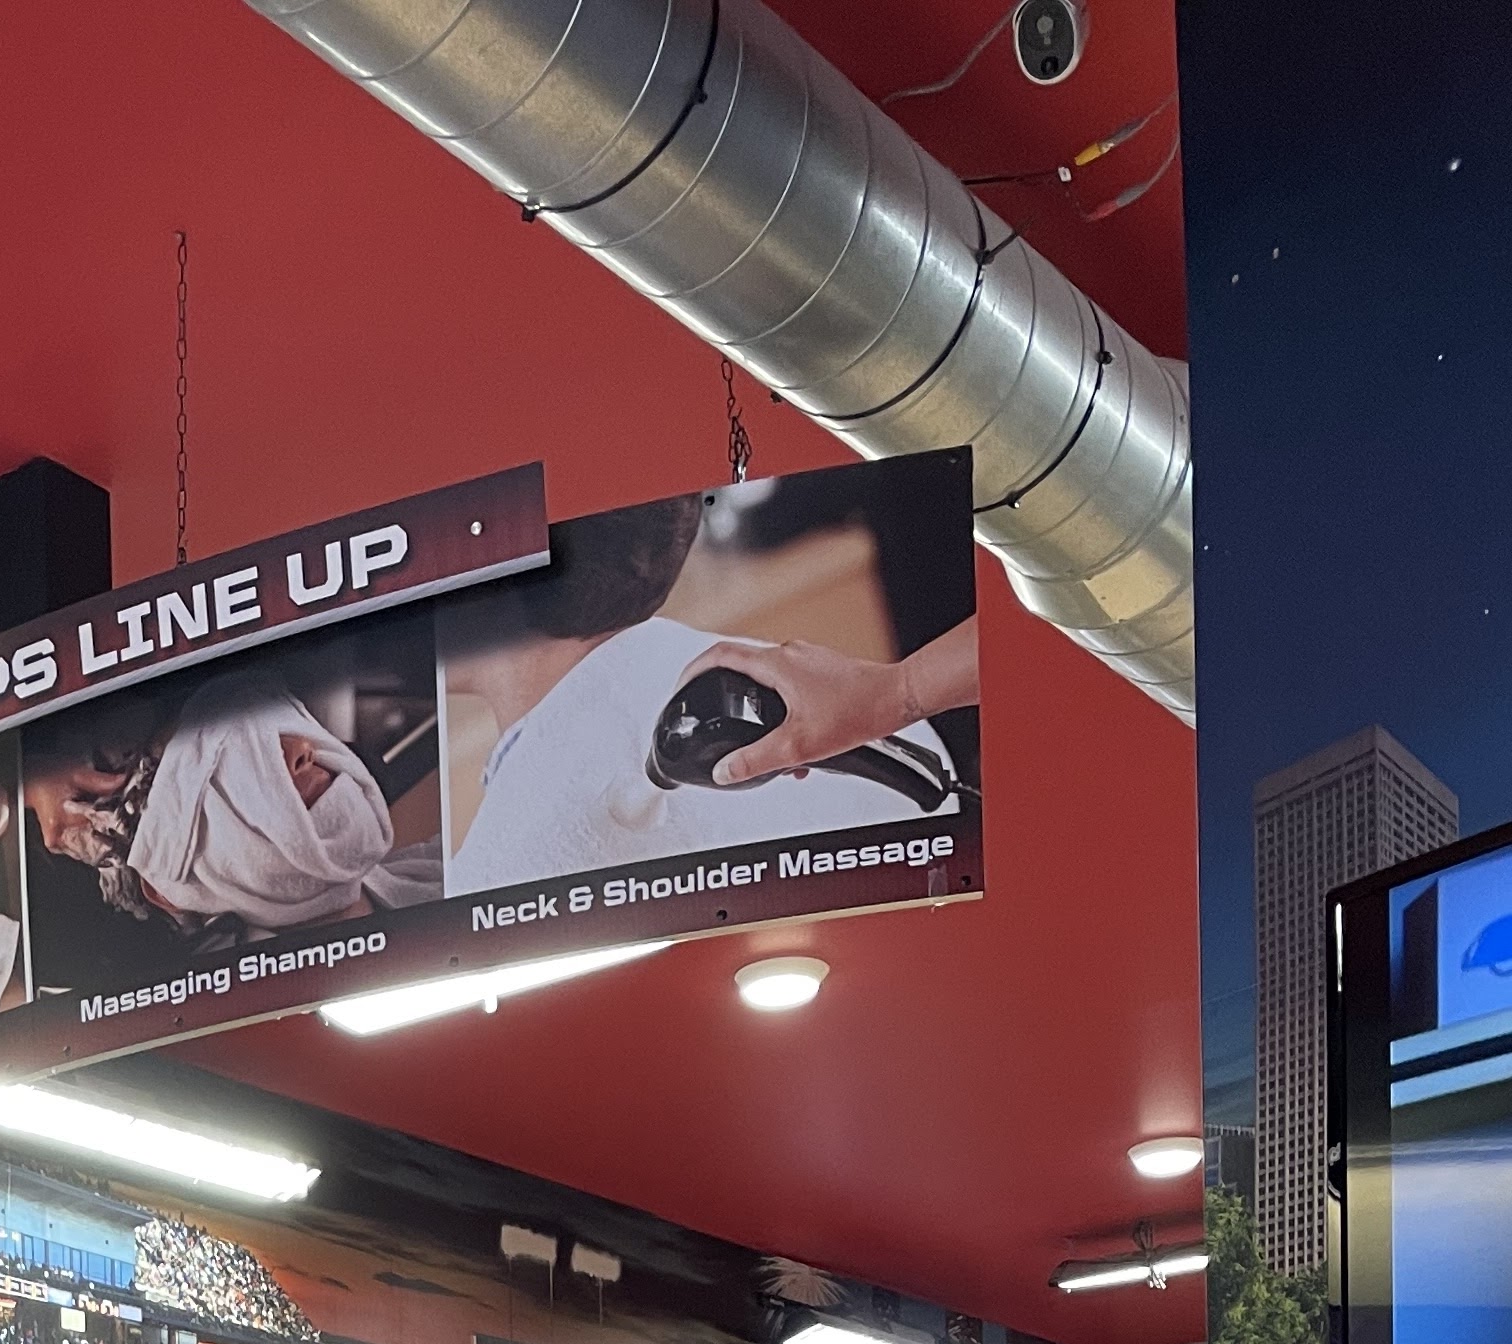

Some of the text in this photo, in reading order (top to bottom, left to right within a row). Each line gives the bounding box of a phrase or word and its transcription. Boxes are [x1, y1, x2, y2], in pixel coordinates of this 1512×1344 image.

[78, 565, 262, 675] LINE
[286, 524, 408, 606] UP
[471, 831, 954, 932] Neck & Shoulder Massage
[80, 929, 387, 1025] Massaging Shampoo
